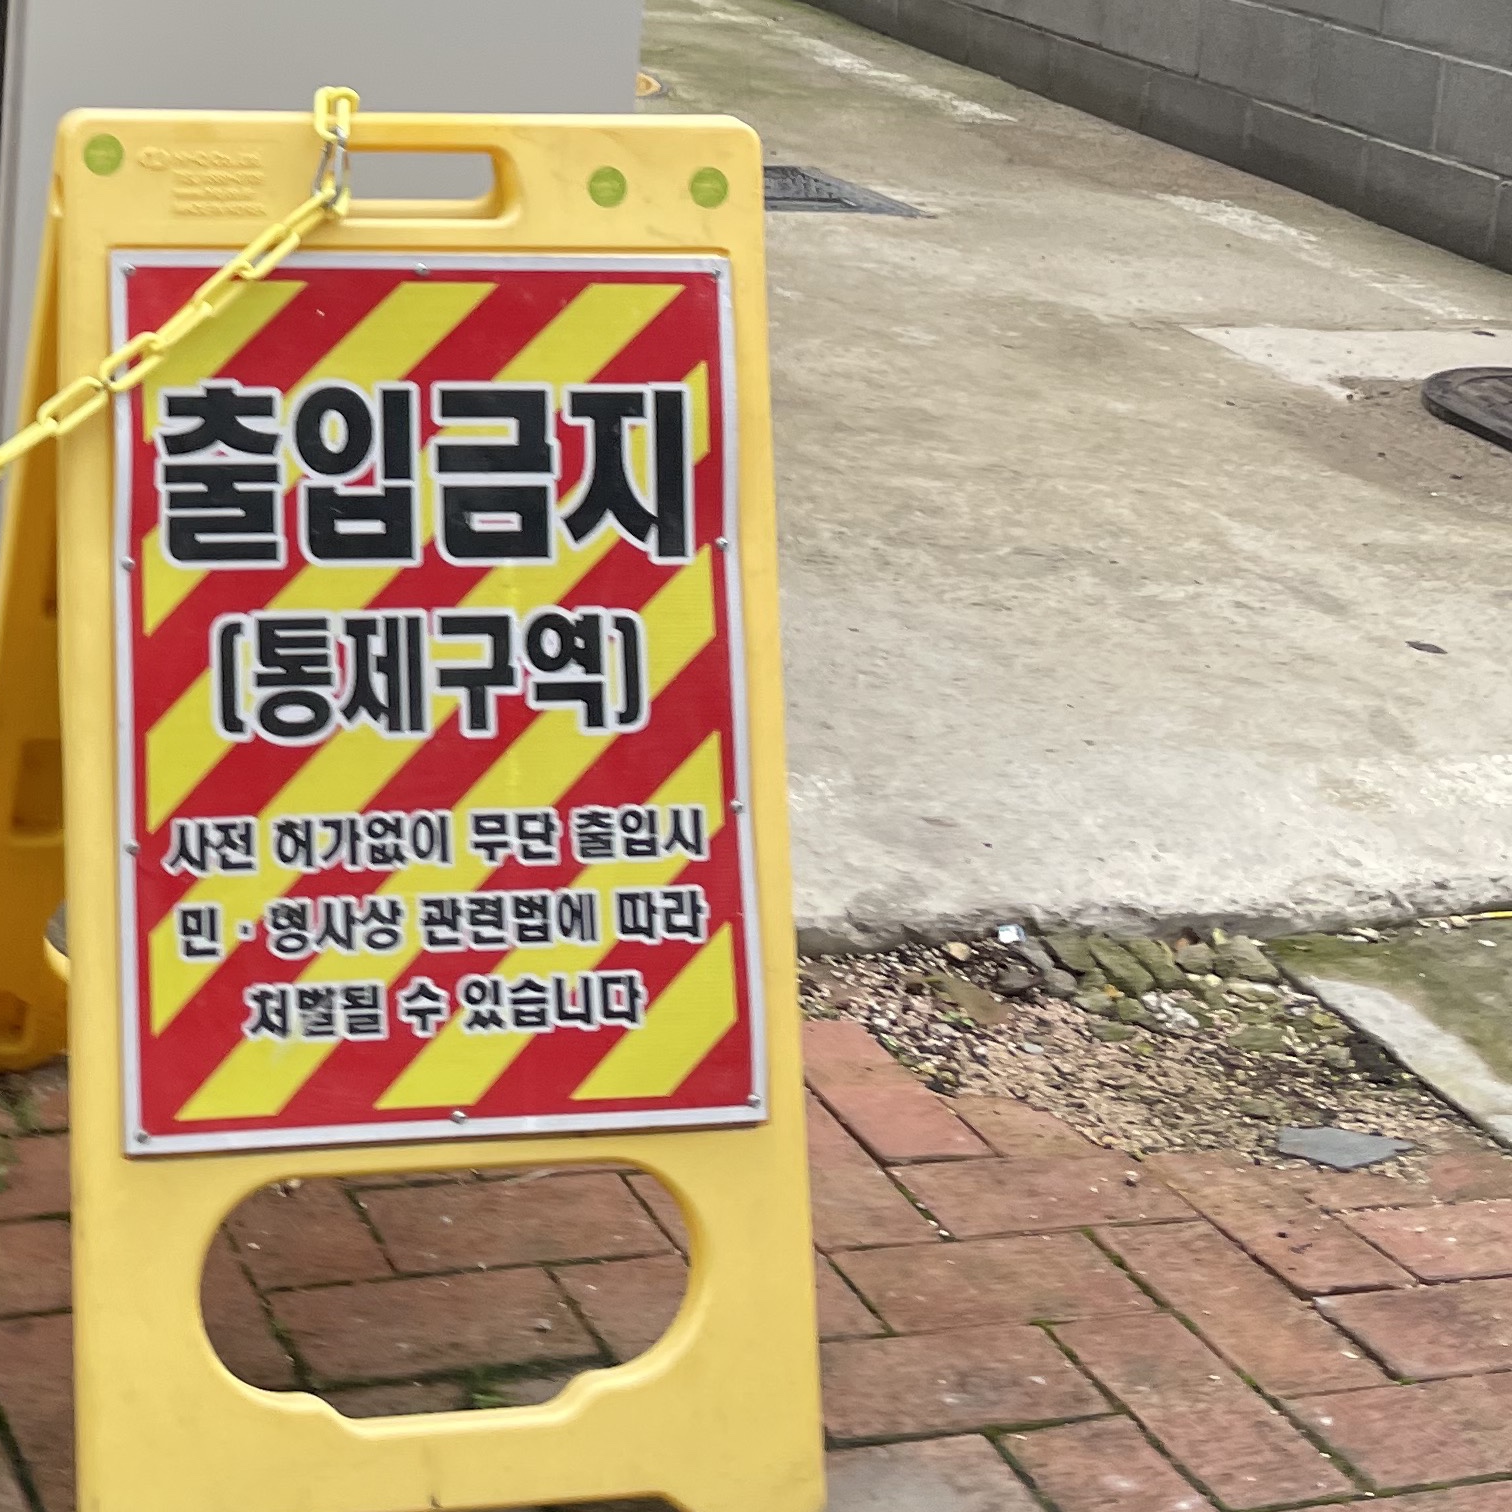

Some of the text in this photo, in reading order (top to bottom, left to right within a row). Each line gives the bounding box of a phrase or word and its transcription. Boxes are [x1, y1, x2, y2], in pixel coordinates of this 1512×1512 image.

[162, 385, 694, 562] 출입금지
[170, 808, 704, 872] 사전 허가없이 무단 출입시
[423, 892, 599, 946] 관련법에
[619, 890, 703, 938] 따라
[251, 974, 643, 1037] 처벌될 수 있습니다
